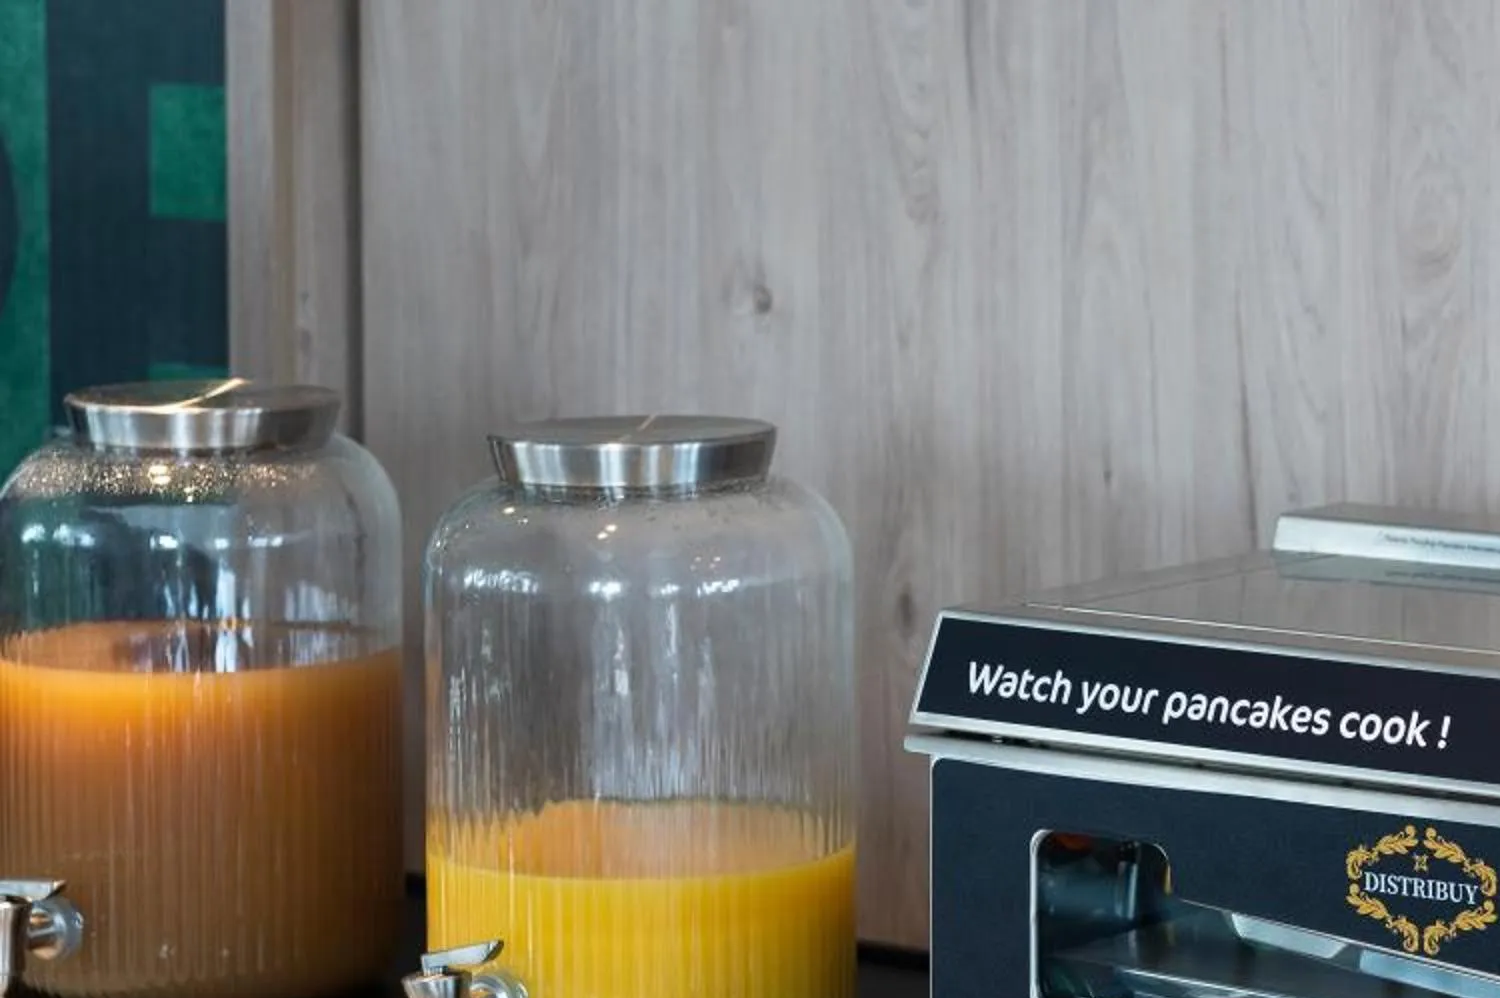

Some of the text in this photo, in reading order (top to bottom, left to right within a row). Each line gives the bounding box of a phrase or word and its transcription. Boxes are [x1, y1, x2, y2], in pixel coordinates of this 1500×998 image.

[968, 661, 1071, 705] Watch
[1076, 681, 1158, 715] your
[1163, 690, 1331, 735] pancakes
[1339, 711, 1427, 748] cook
[1364, 871, 1478, 905] DISTRIBUY
